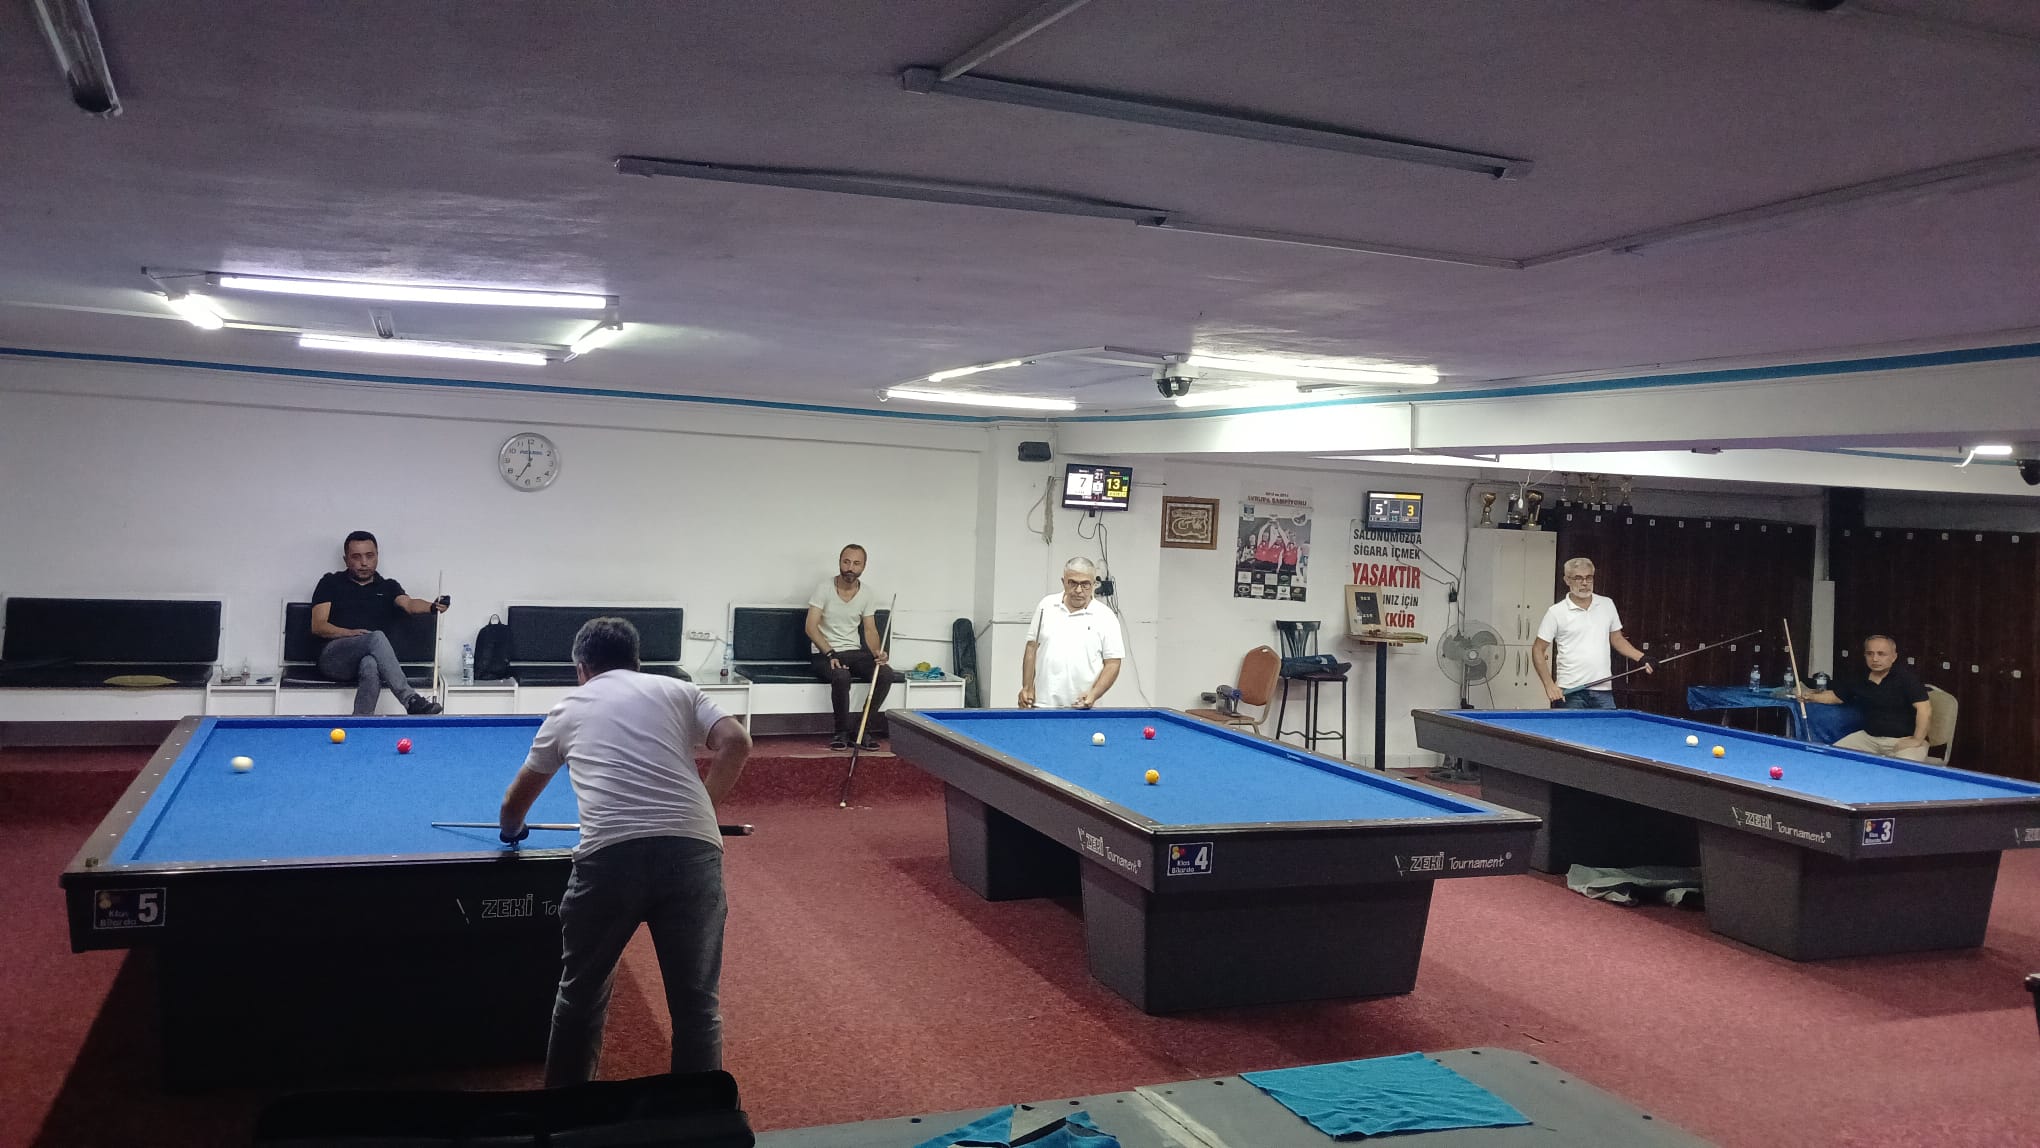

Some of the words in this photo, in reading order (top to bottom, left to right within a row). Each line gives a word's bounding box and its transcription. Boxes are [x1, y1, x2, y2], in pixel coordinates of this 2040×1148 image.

[1080, 476, 1087, 488] 7
[1107, 478, 1121, 490] 13
[1375, 503, 1384, 515] 5
[1407, 505, 1415, 517] 3
[1353, 528, 1422, 544] SALONUMUZDA
[1353, 542, 1388, 557] SİGARA
[1391, 545, 1421, 561] İÇMEK
[1352, 562, 1421, 589] YASAKTIR
[1401, 593, 1419, 609] İÇİN
[1776, 821, 1826, 844] Tournament
[1881, 821, 1892, 842] 3
[1105, 846, 1138, 874] Tournament
[1194, 846, 1209, 870] 4
[1410, 851, 1445, 871] ZEKİ
[1449, 856, 1505, 870] Tournament
[138, 893, 159, 923] 5
[481, 893, 534, 918] ZEKİ
